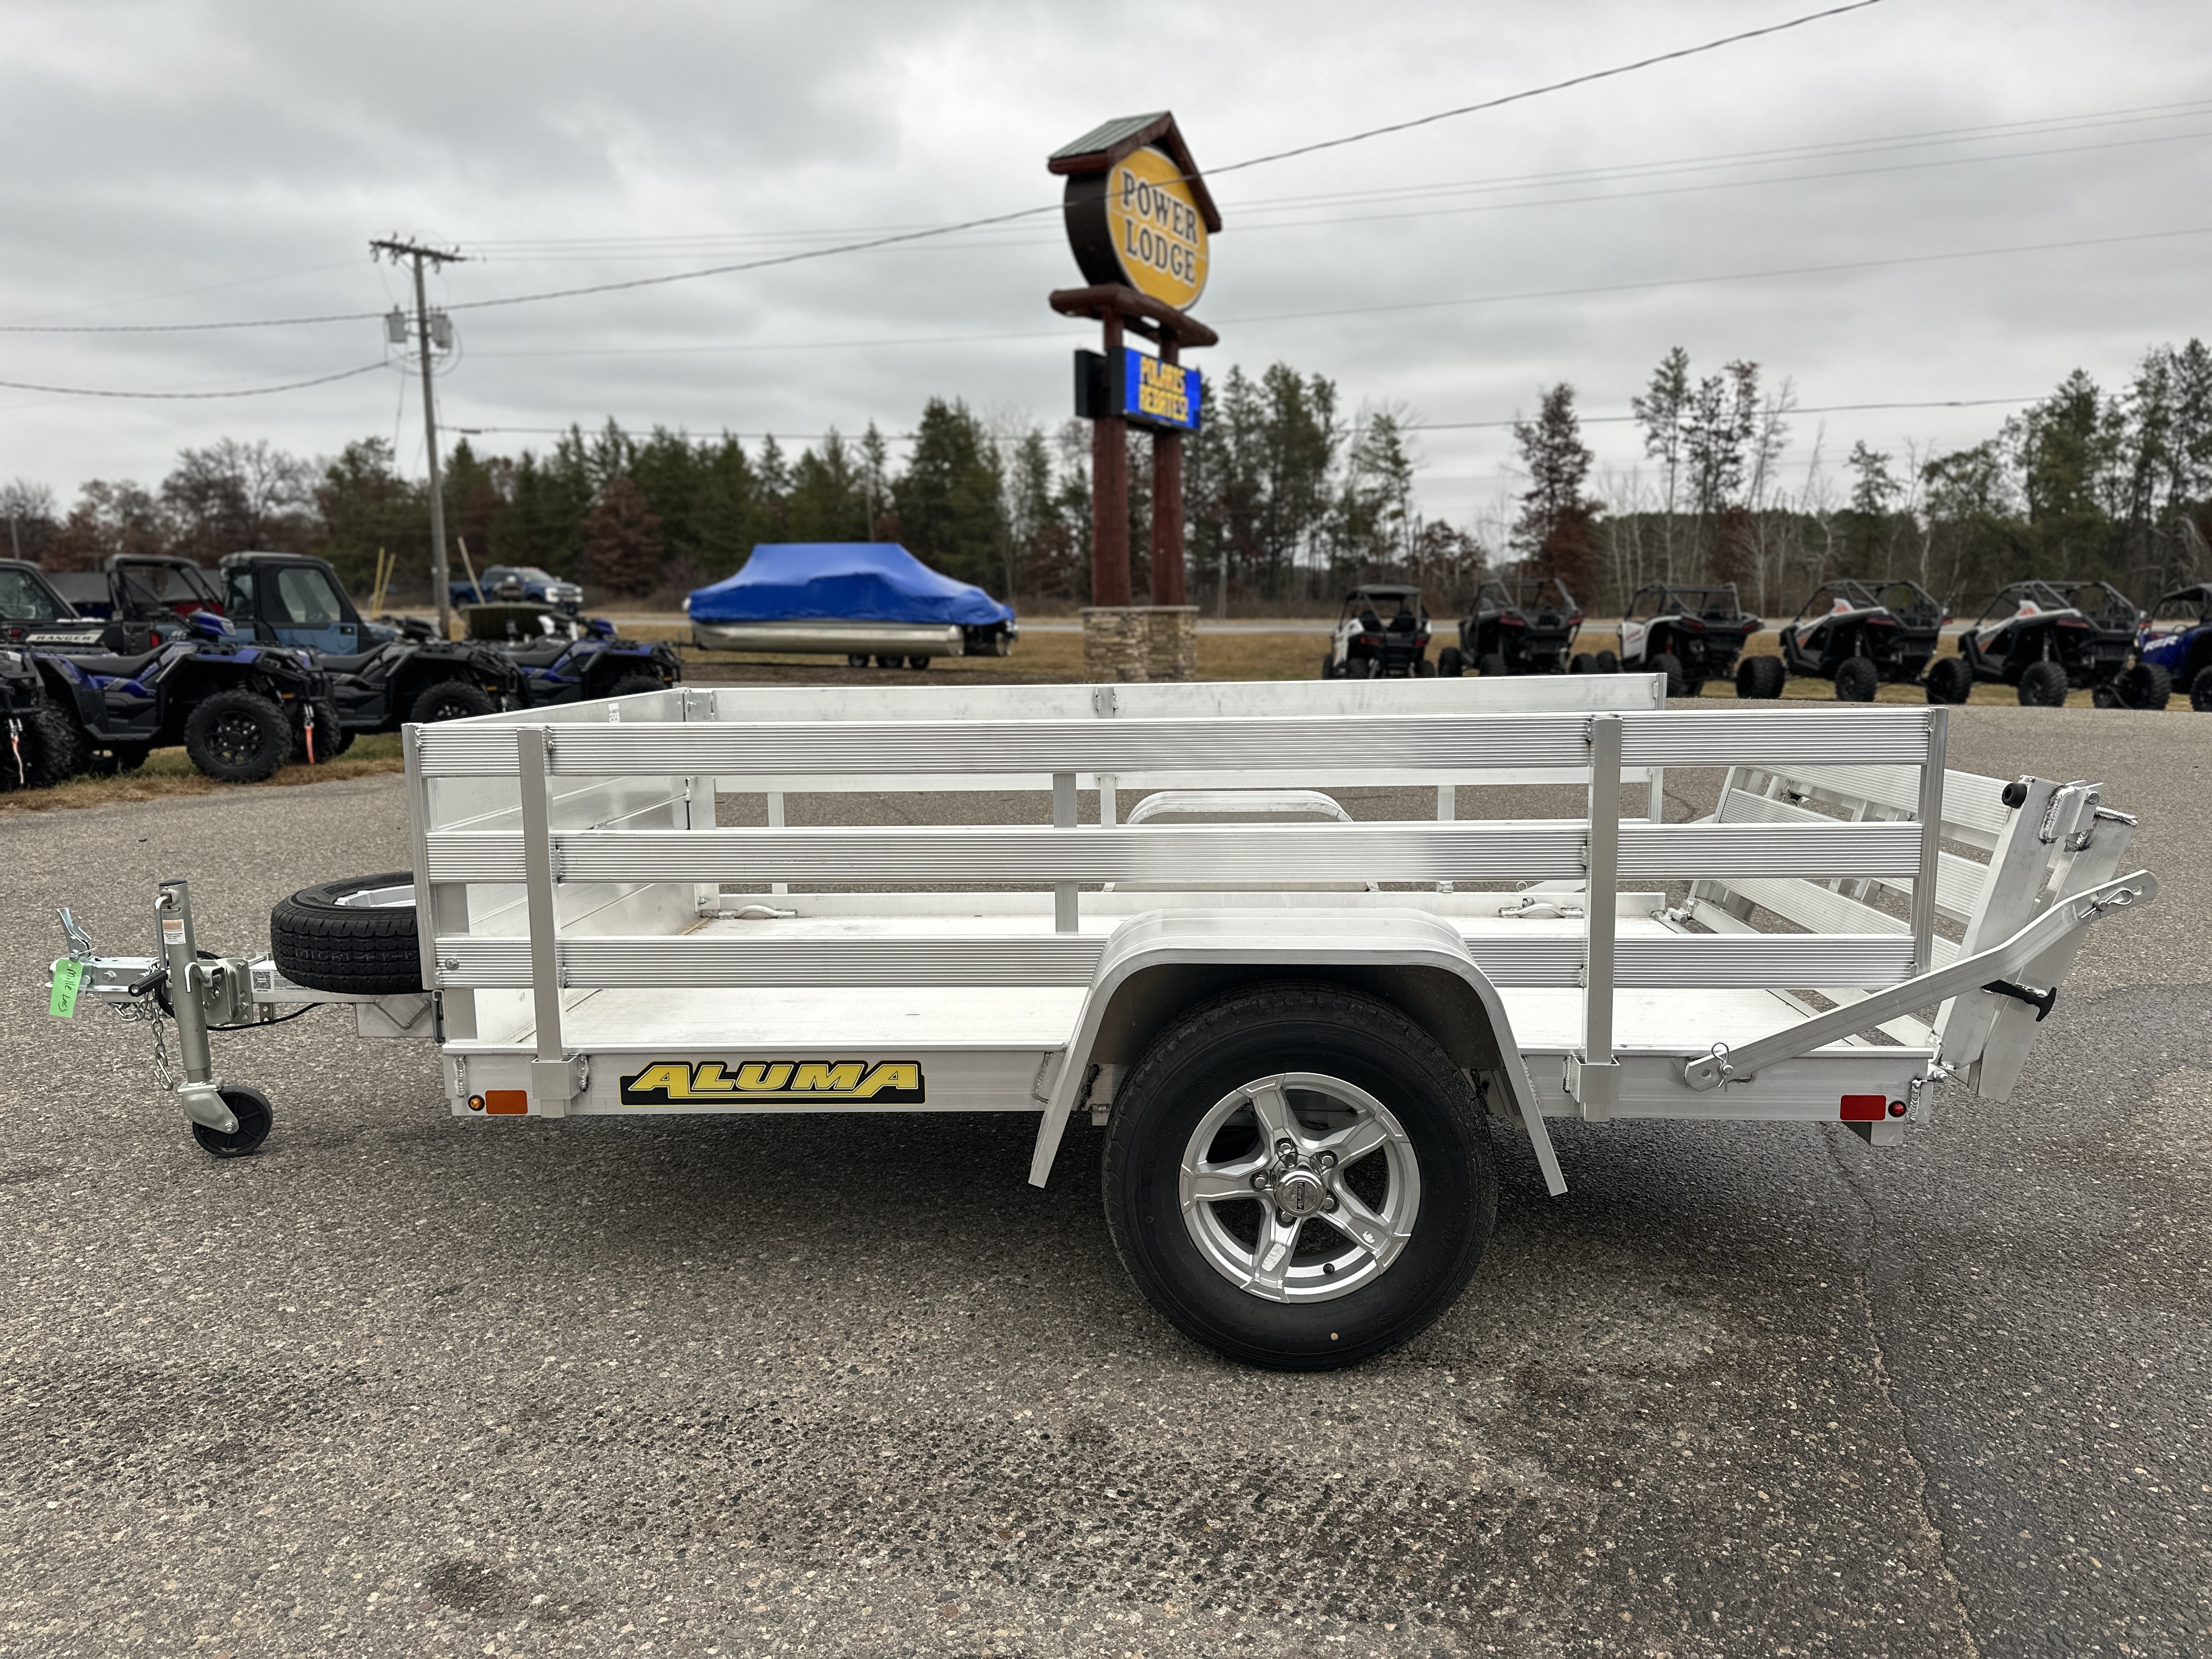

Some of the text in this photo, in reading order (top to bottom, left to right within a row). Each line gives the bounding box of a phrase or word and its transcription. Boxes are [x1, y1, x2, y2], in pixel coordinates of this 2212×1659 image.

[1121, 170, 1198, 246] POWER
[1125, 217, 1195, 284] LODGE
[628, 1064, 918, 1098] ALUMA
[1146, 1069, 1221, 1162] WESTLAKE
